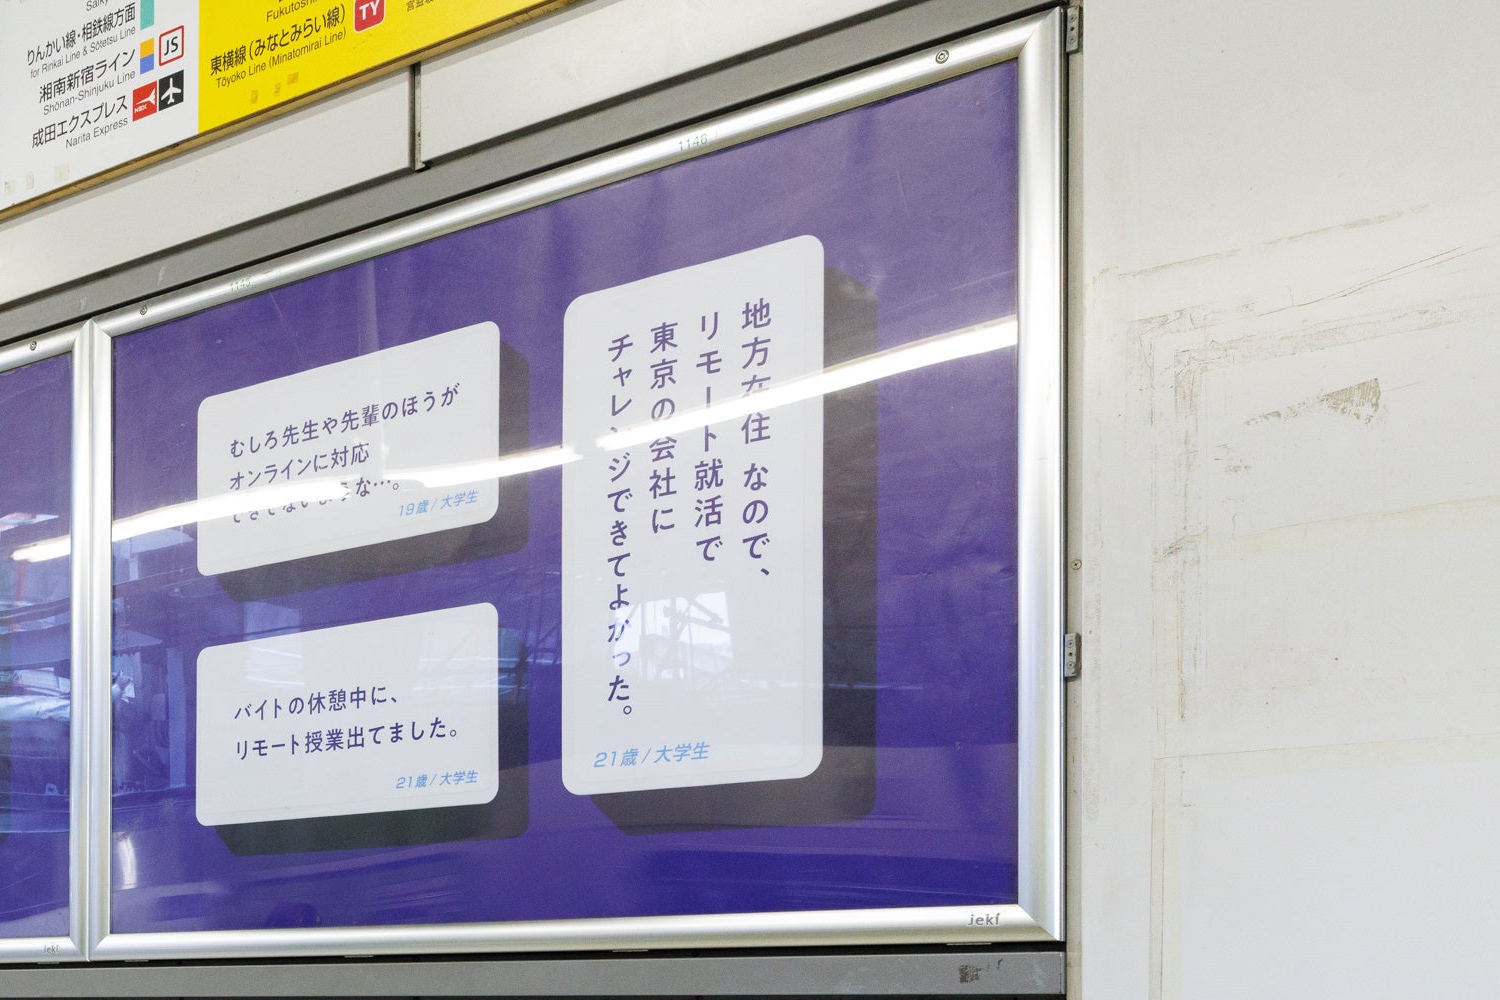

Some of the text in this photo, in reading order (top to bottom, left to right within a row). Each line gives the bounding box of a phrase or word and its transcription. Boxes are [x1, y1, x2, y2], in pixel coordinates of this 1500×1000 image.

[27, 2, 135, 66] りんかい線・相鉄線方面
[359, 0, 380, 20] TY
[30, 26, 135, 79] for Rinkai Line & Sōtetsu Line
[164, 36, 178, 56] JS
[211, 4, 346, 76] 東横線(みなとみらい線)
[216, 27, 346, 88] Tōyoko Line (Minatomirai Line)
[39, 49, 135, 103] 湘南新宿ライン
[43, 70, 135, 115] Shōnan-Shinjuku Line
[32, 95, 128, 148] 成田エクスプレス
[66, 118, 128, 148] Narita Express
[230, 382, 460, 459] むしろ先生や先輩のほうが
[230, 442, 370, 491] オンラインに対応
[608, 333, 633, 715] チャレジできてよかった。
[235, 684, 398, 722] バイトの休憩中に、
[236, 715, 457, 761] リモート授業出てました。
[968, 913, 1000, 926] jeki
